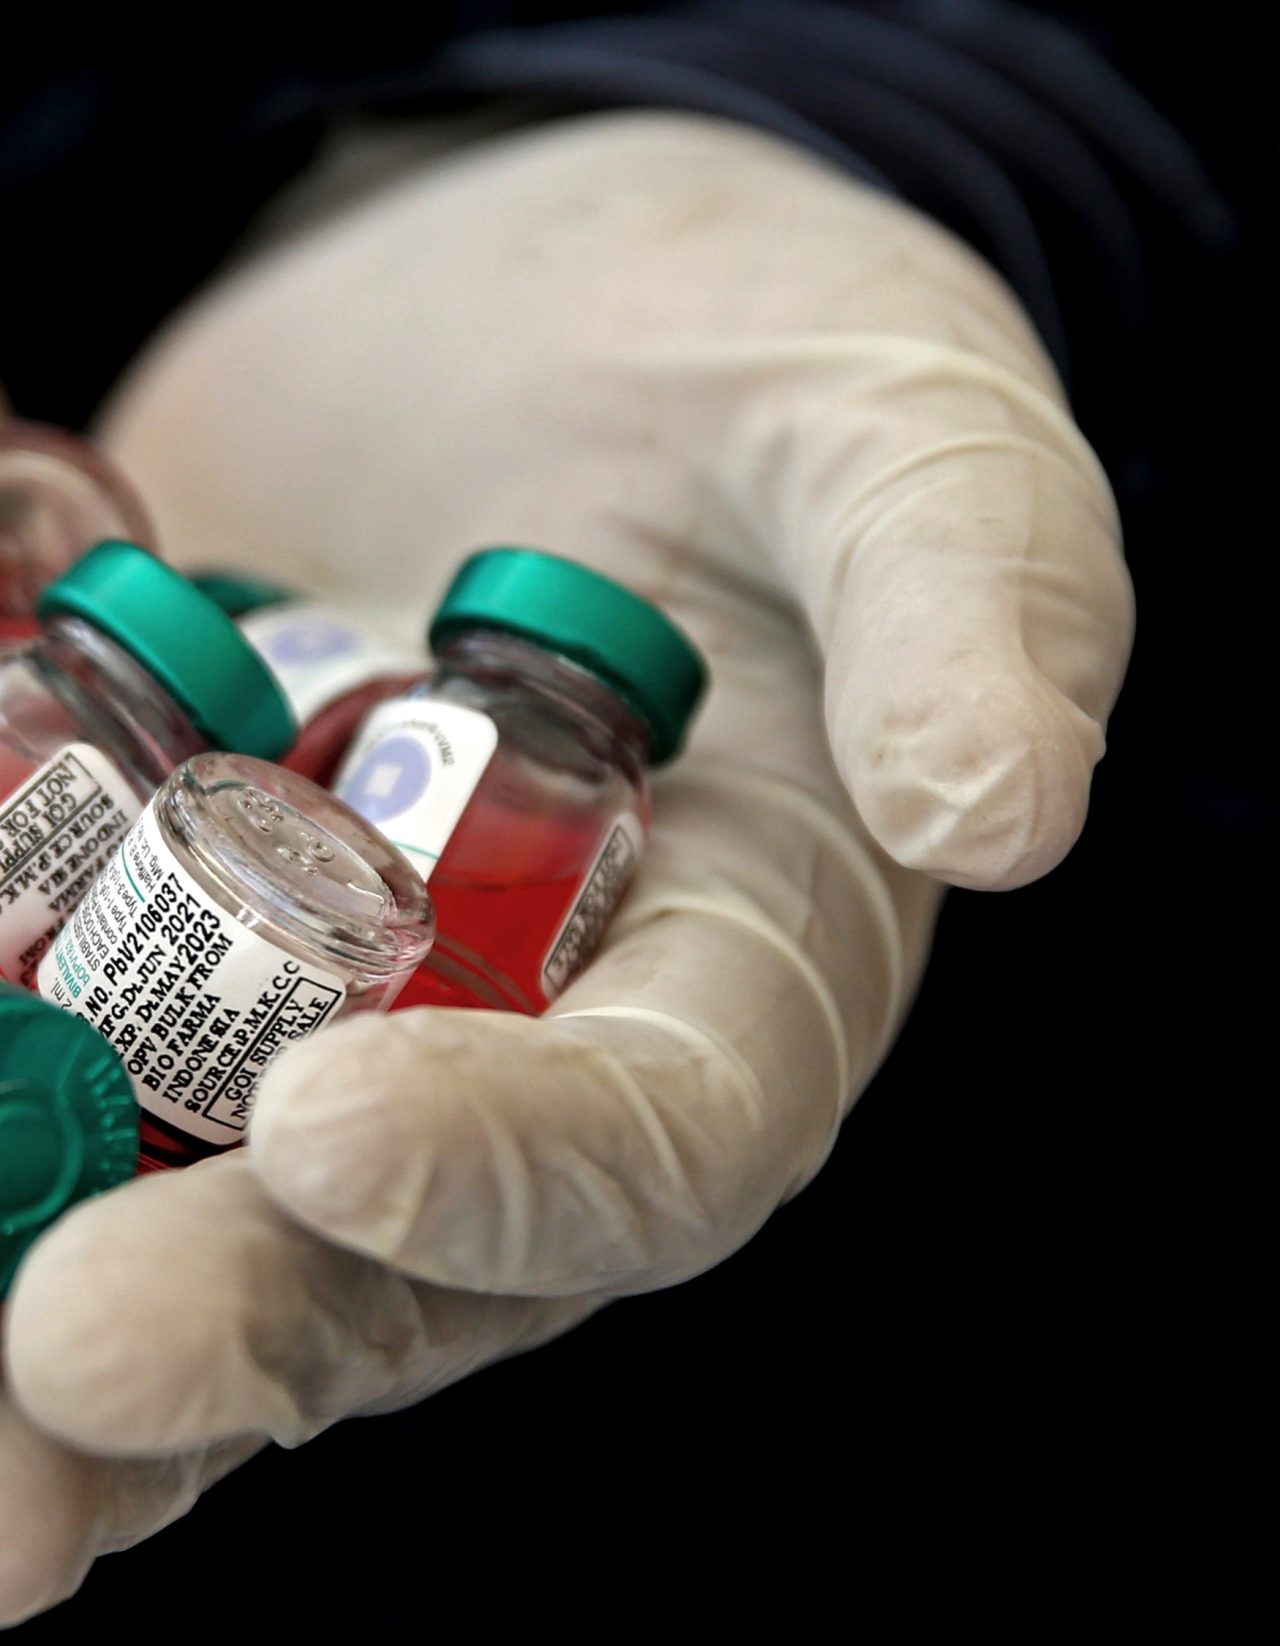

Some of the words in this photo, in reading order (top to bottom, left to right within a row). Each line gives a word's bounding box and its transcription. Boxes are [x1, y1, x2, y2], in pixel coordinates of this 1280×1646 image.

[36, 764, 77, 807] NOT
[0, 799, 41, 838] FOR
[42, 793, 77, 828] GOI
[38, 809, 129, 896] INDONESIA
[133, 852, 157, 893] Haffkine
[149, 854, 164, 881] Mfg.
[95, 904, 118, 944] contains
[111, 905, 127, 934] Type
[122, 890, 138, 918] Type
[161, 893, 201, 947] 2021
[88, 925, 109, 959] EACH
[103, 872, 184, 986] PbV2106037
[112, 1022, 143, 1061] XP.
[177, 909, 221, 966] 2023
[127, 1036, 158, 1075] OPV
[151, 986, 195, 1041] BULK
[186, 933, 233, 990] FROM
[288, 997, 330, 1041] SALE
[142, 1055, 175, 1091] BIO
[166, 992, 222, 1057] FARMA
[162, 1007, 241, 1104] INDONESIA
[224, 1067, 258, 1101] GOI
[249, 998, 306, 1066] SUPPLY
